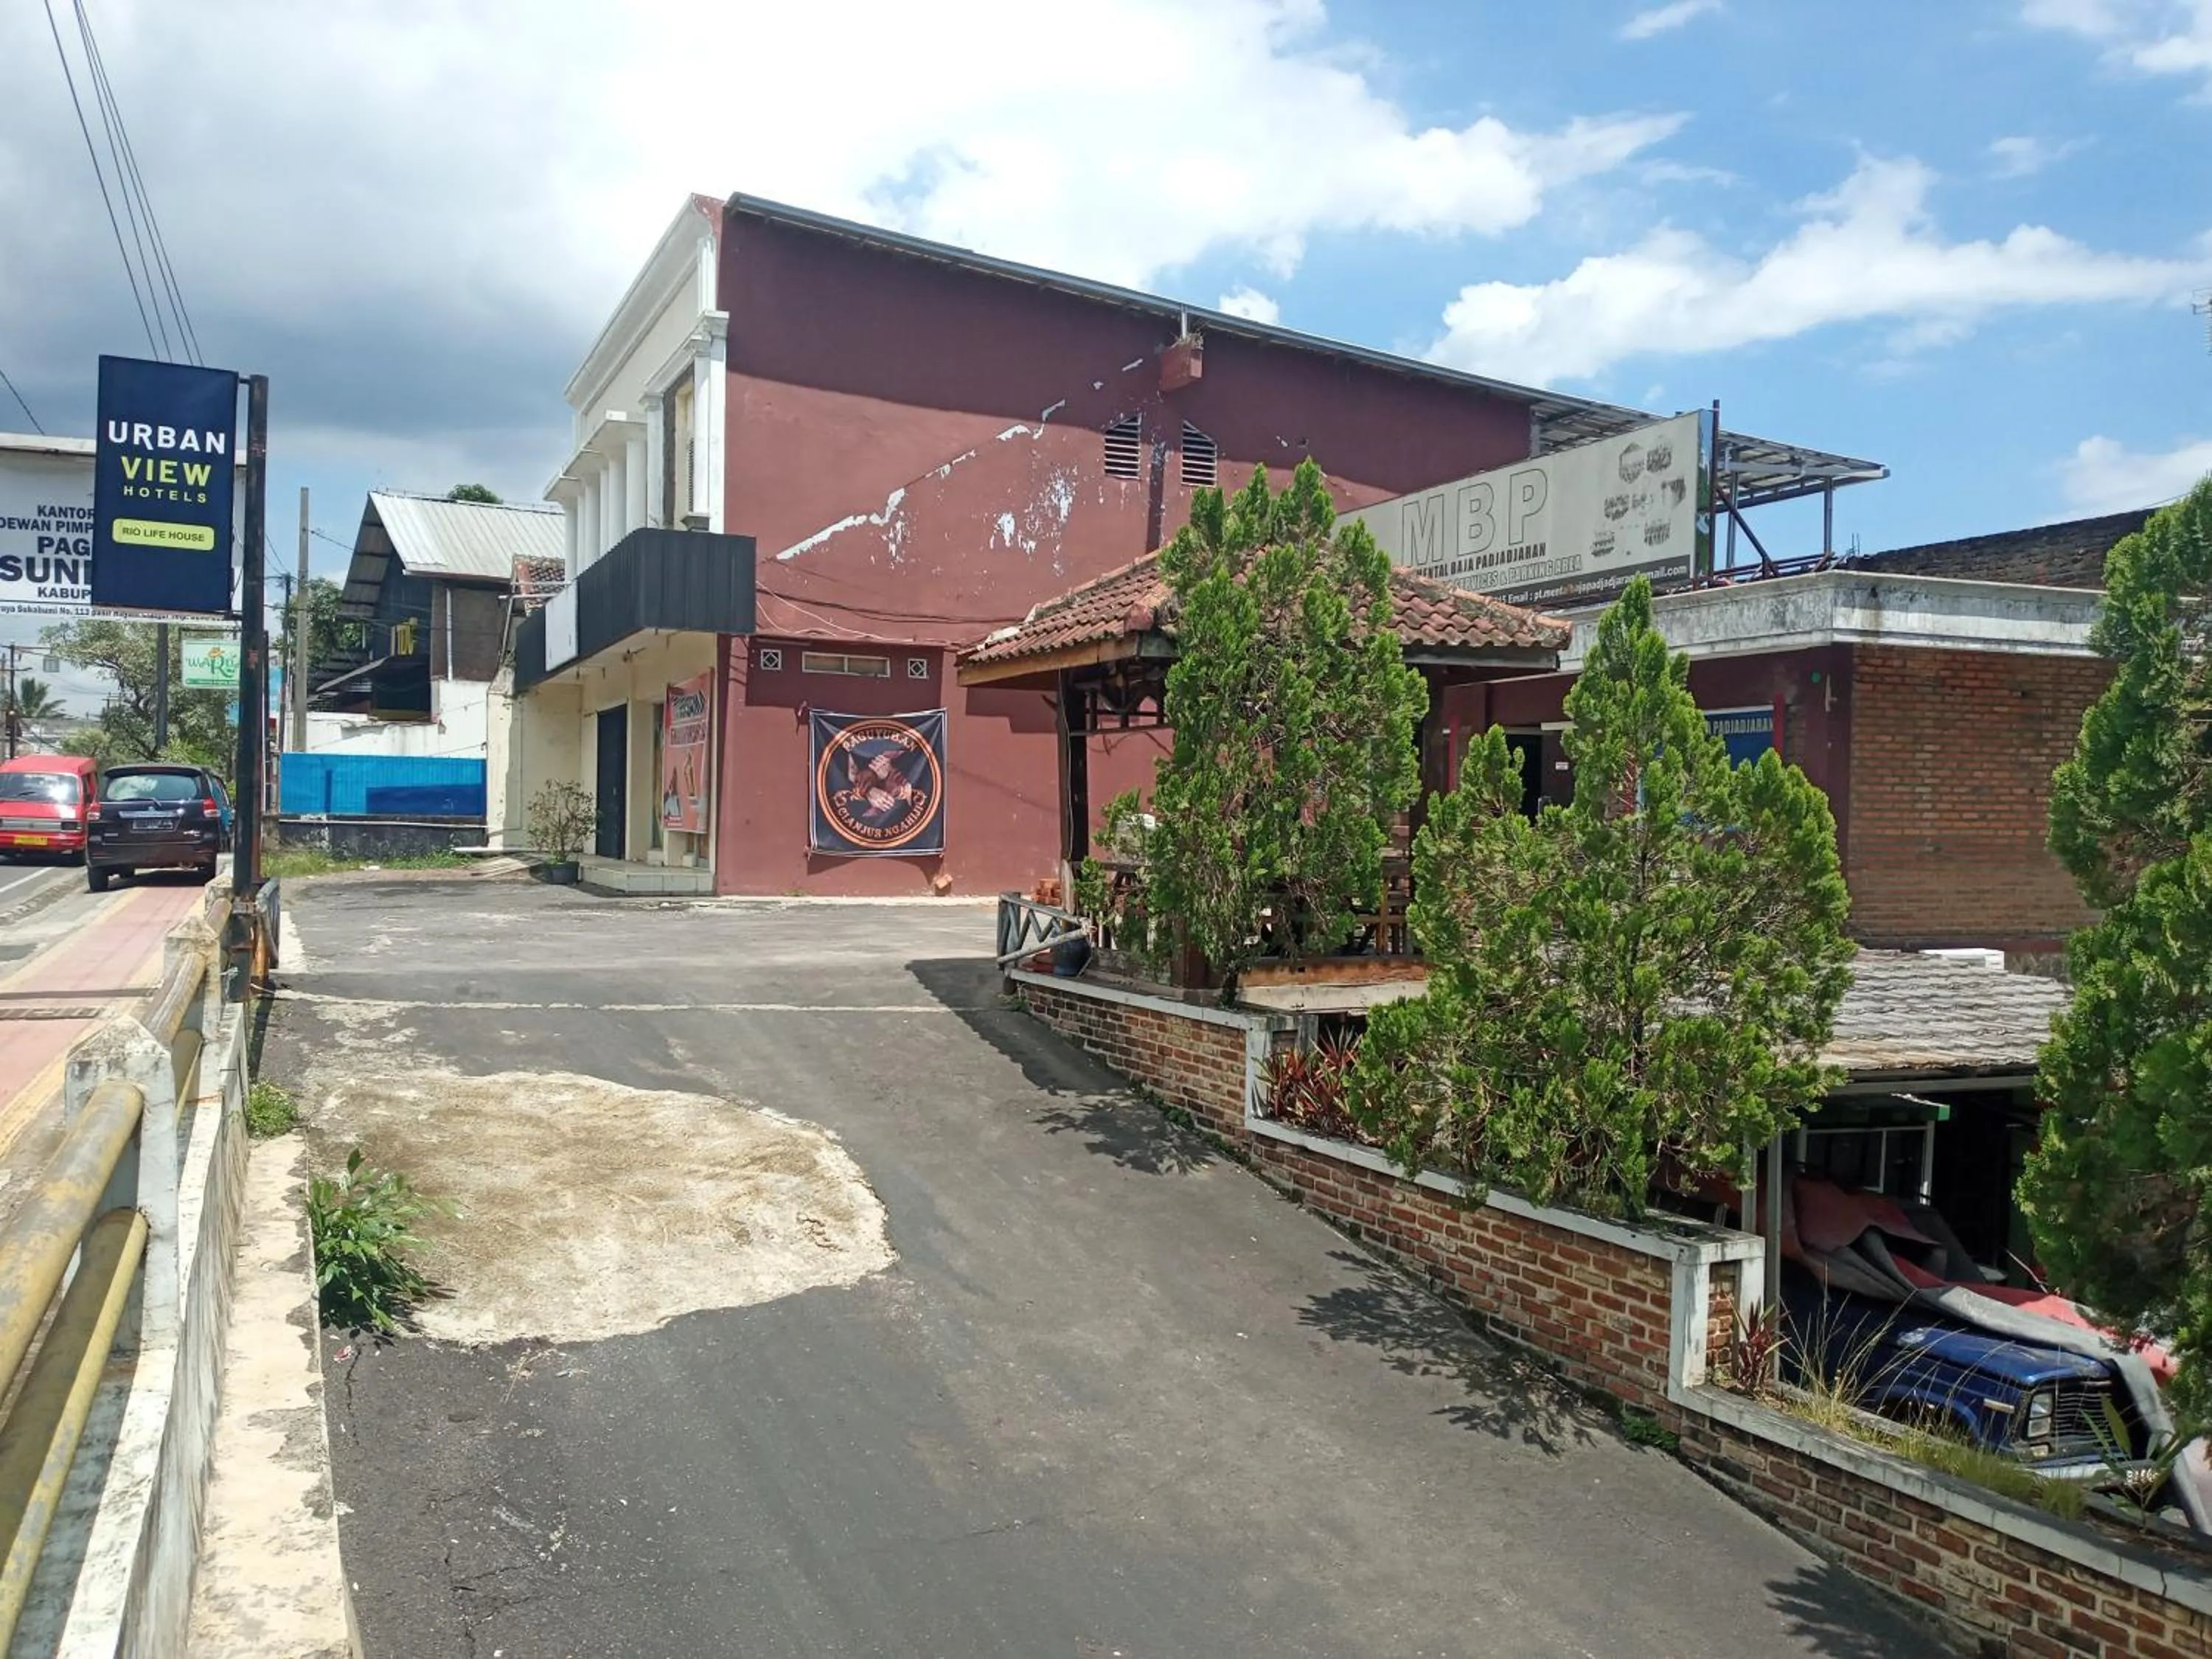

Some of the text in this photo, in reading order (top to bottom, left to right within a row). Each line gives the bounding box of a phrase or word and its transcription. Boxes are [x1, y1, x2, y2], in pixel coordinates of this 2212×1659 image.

[108, 420, 225, 454] URBAN
[121, 455, 212, 487] VIEW
[123, 485, 206, 504] HOTELS
[0, 517, 51, 532] DEWAN
[1402, 468, 1548, 566] MBP
[122, 526, 204, 541] RIO LIFE HOUSE
[1475, 542, 1546, 570] PADJADJARAN
